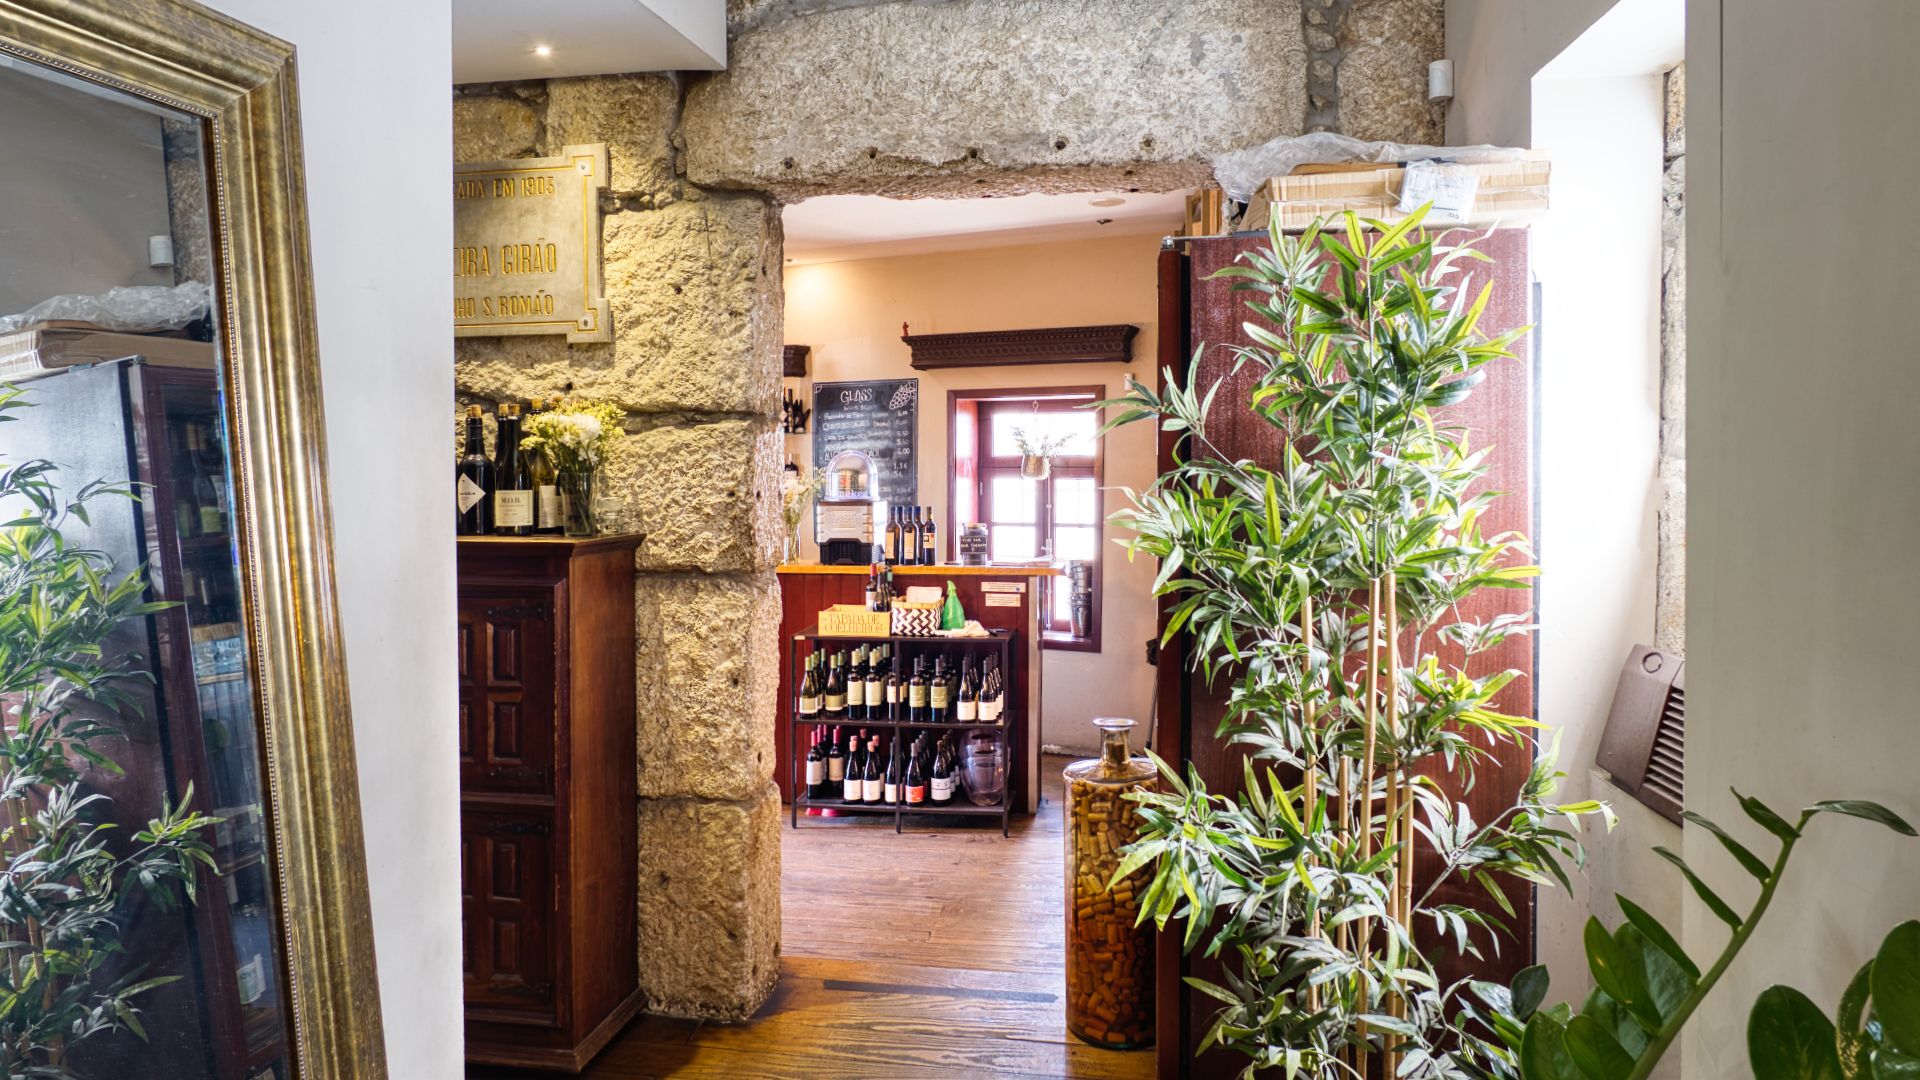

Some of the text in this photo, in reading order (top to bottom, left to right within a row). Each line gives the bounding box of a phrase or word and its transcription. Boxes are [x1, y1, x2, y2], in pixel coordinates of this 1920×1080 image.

[493, 177, 515, 198] EM
[501, 237, 557, 275] GIRÃO
[482, 296, 495, 318] S.
[498, 290, 554, 317] ROMÃO
[840, 388, 873, 405] GLASS
[824, 623, 883, 633] COELHEIROS
[828, 613, 880, 624] TAPADA DE
